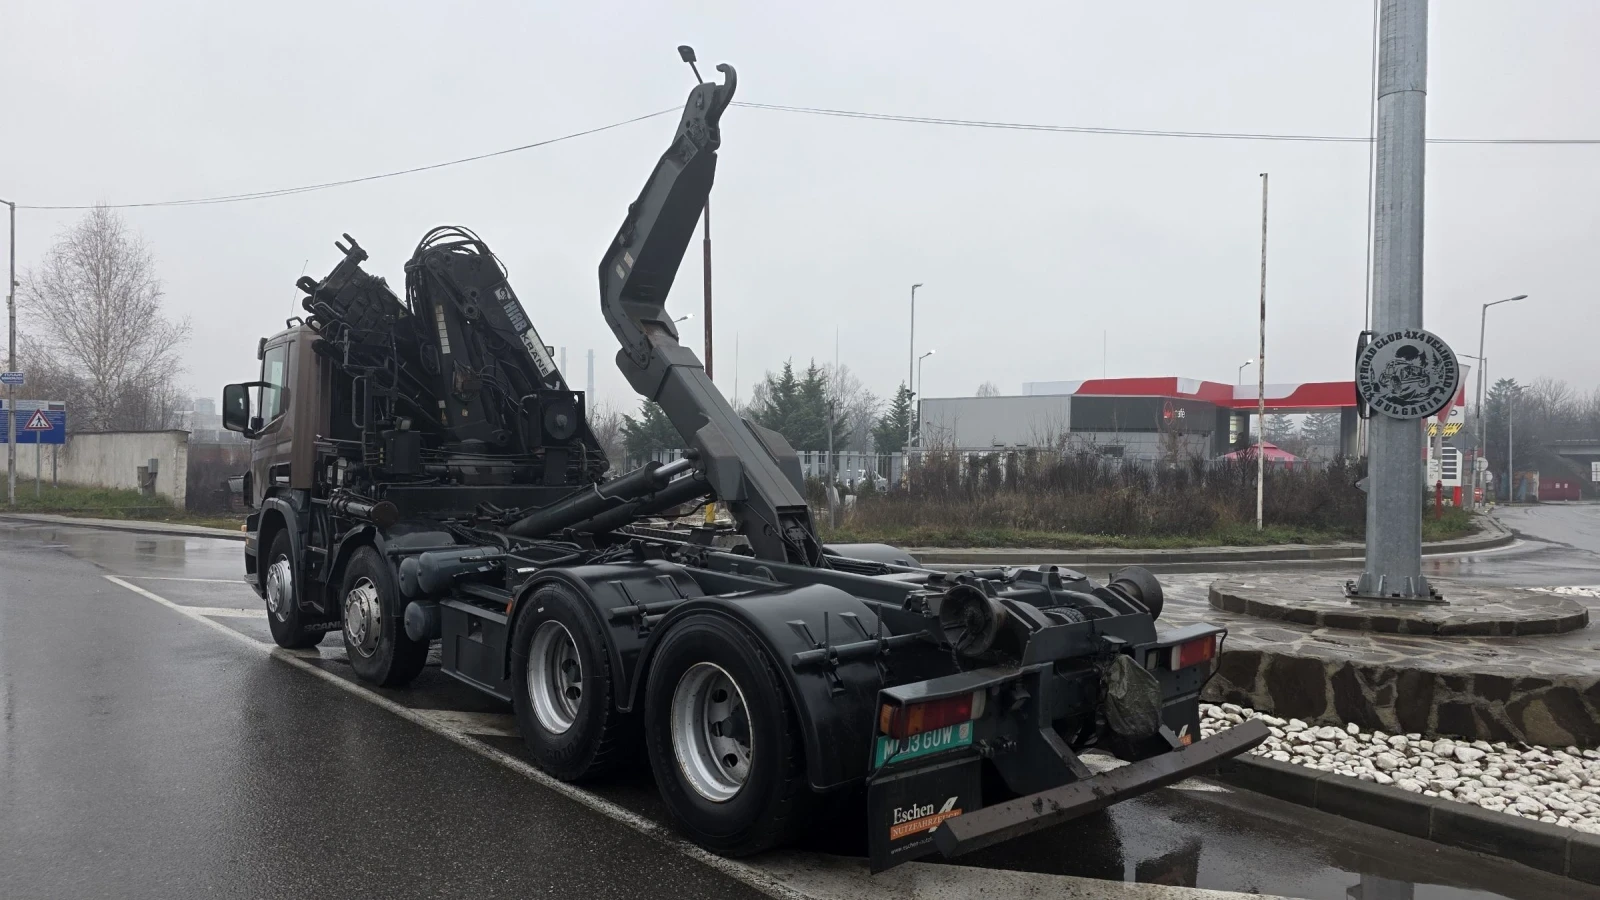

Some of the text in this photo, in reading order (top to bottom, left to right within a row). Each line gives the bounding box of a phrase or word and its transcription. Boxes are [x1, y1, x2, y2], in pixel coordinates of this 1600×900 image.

[503, 300, 528, 332] HIAB
[521, 332, 549, 376] KRÄNE
[1360, 330, 1455, 393] OFFROAD CLUB 4X4 VELINGRAD
[1374, 396, 1442, 416] BULGARIA
[893, 802, 935, 825] Eschen
